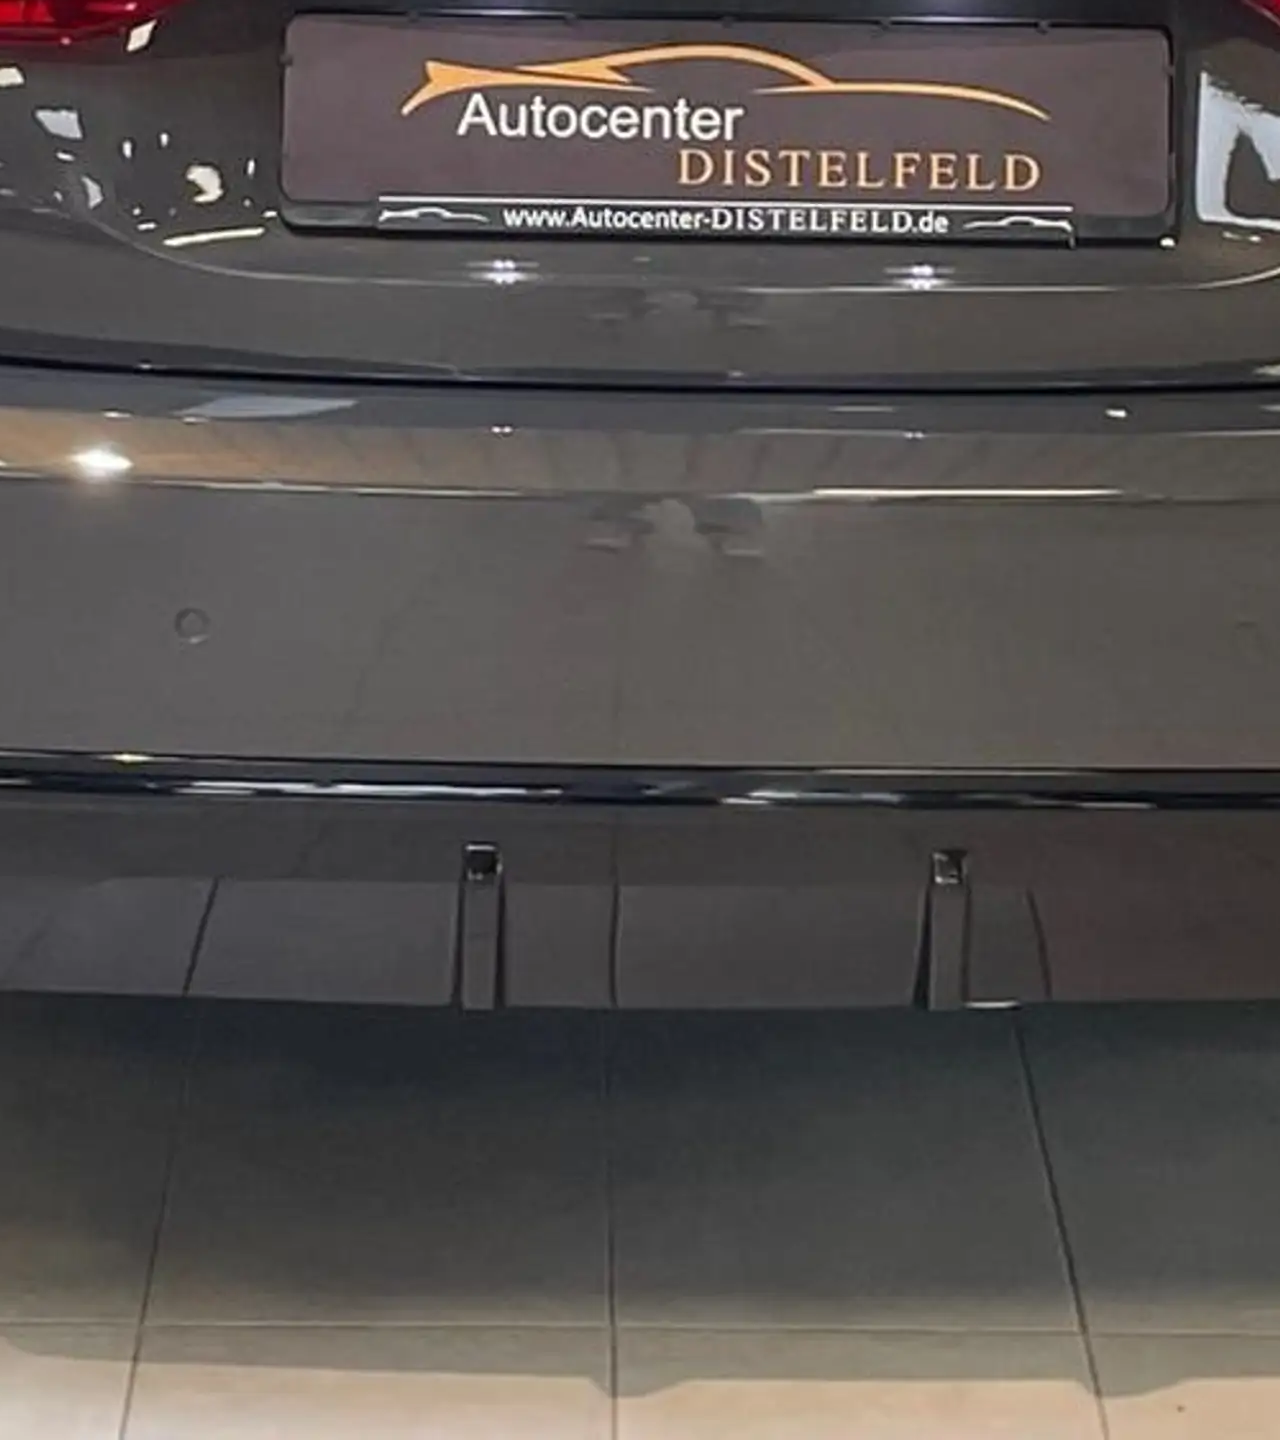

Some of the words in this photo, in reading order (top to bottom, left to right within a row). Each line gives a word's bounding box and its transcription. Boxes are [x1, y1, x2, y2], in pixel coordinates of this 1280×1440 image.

[456, 93, 744, 141] Autocenter
[678, 148, 1040, 191] DISTELFELD
[503, 207, 949, 234] www.Autocenter-DISTELFELD.de
